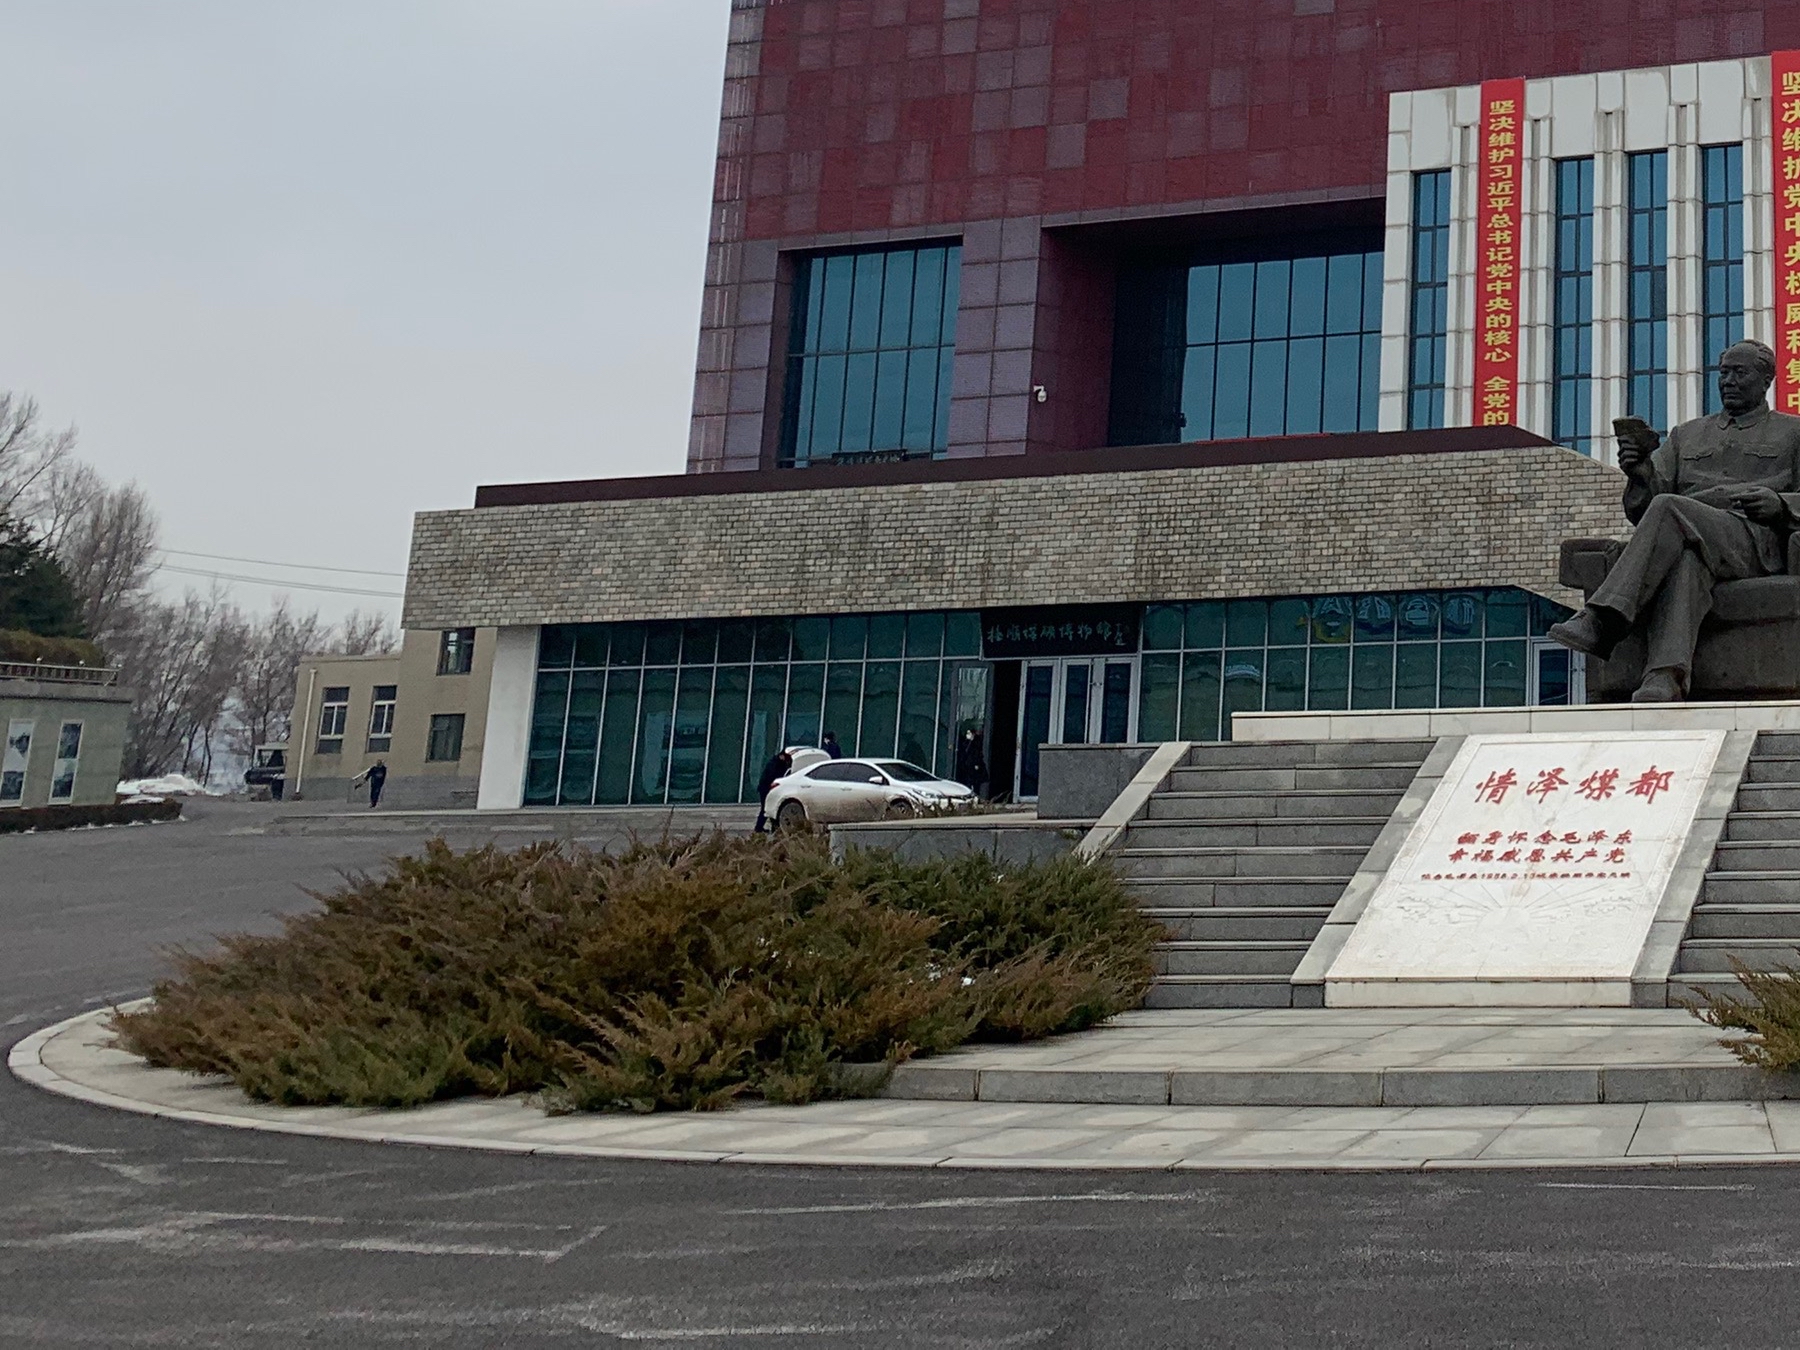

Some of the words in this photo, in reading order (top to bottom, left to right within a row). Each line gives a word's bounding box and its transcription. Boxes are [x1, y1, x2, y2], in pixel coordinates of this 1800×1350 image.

[1484, 100, 1517, 363] 坚决维护习近平总书记党中央的核心
